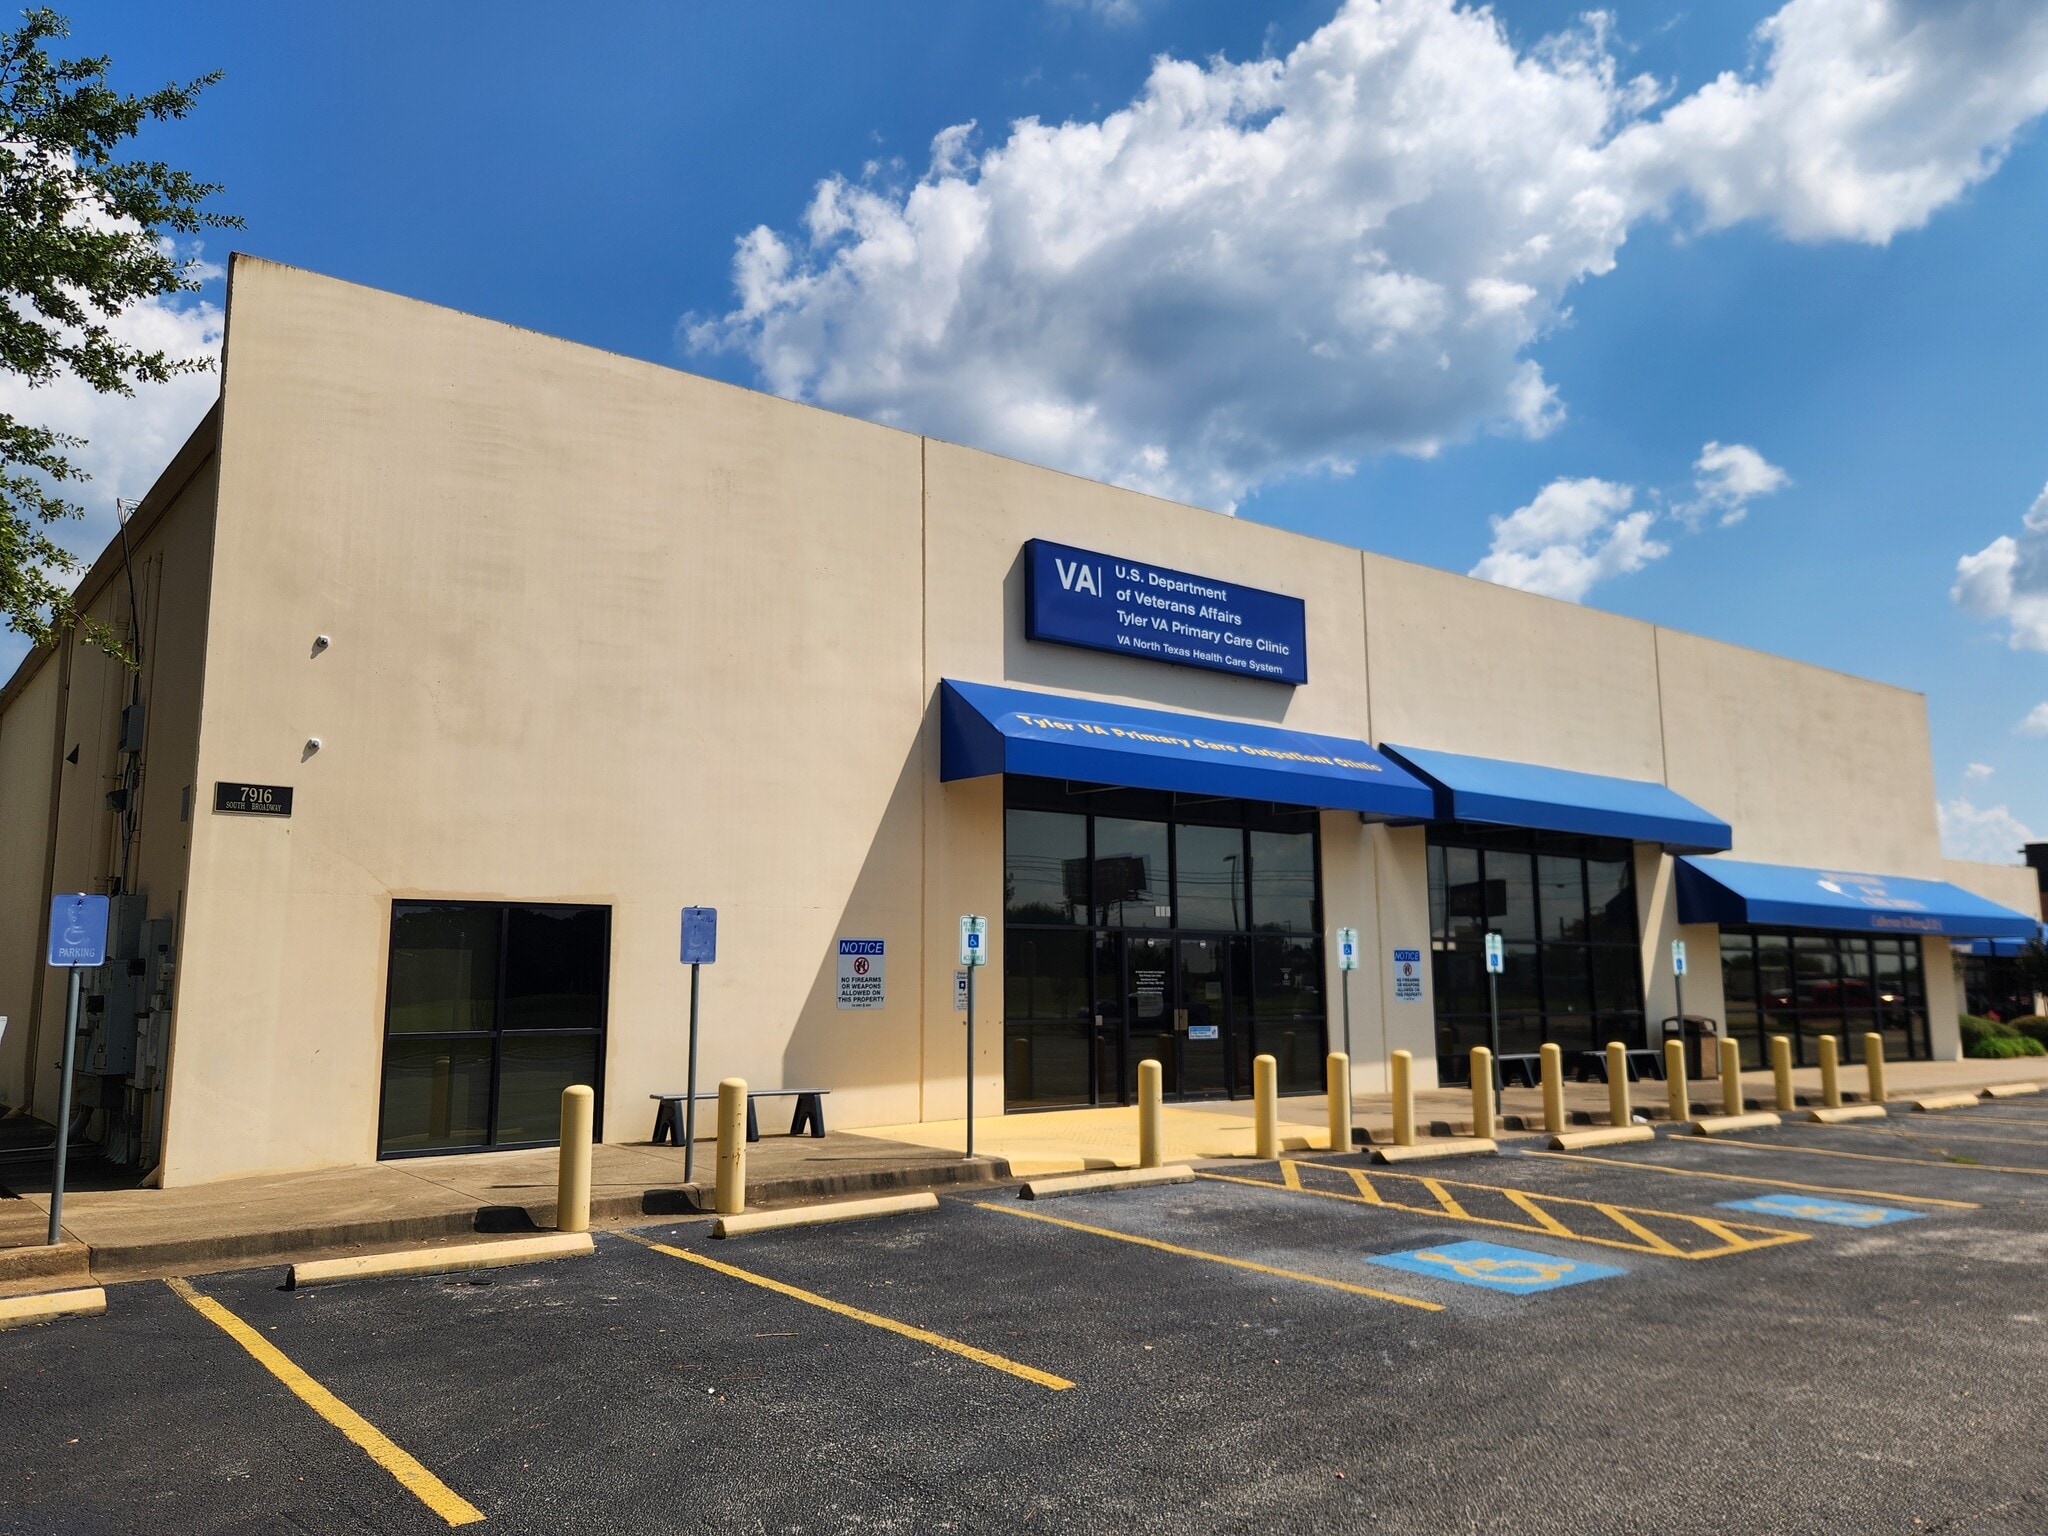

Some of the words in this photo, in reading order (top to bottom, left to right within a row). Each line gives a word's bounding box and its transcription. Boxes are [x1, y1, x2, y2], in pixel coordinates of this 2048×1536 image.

[1055, 558, 1097, 596] VA
[1115, 564, 1144, 583] U.S.
[1148, 572, 1227, 602] Department
[1116, 588, 1131, 602] of
[1134, 591, 1196, 616] Veterans
[1199, 607, 1242, 626] Affairs
[1116, 610, 1148, 629] Tyler
[1151, 616, 1169, 632] VA
[1172, 622, 1220, 645] Primary
[1223, 632, 1253, 648] Care
[1256, 638, 1289, 656] Clinic
[1116, 634, 1131, 647] VA
[1133, 638, 1161, 652] North
[1162, 643, 1191, 657] Texas
[1192, 649, 1223, 663] Health
[1225, 655, 1247, 668] Care
[1249, 659, 1283, 674] System
[1016, 714, 1074, 732] Tyler
[1077, 722, 1109, 736] VA
[1110, 727, 1190, 748] Primary
[1192, 738, 1238, 753] Care
[1240, 745, 1334, 766] Outpatient
[1332, 757, 1382, 772] Clinic
[225, 801, 246, 810] SOUTH
[251, 802, 282, 812] BROADWAY
[240, 786, 272, 804] 7916
[58, 947, 96, 958] PARKING
[840, 942, 884, 953] NOTICE
[1395, 951, 1419, 960] NOTICE
